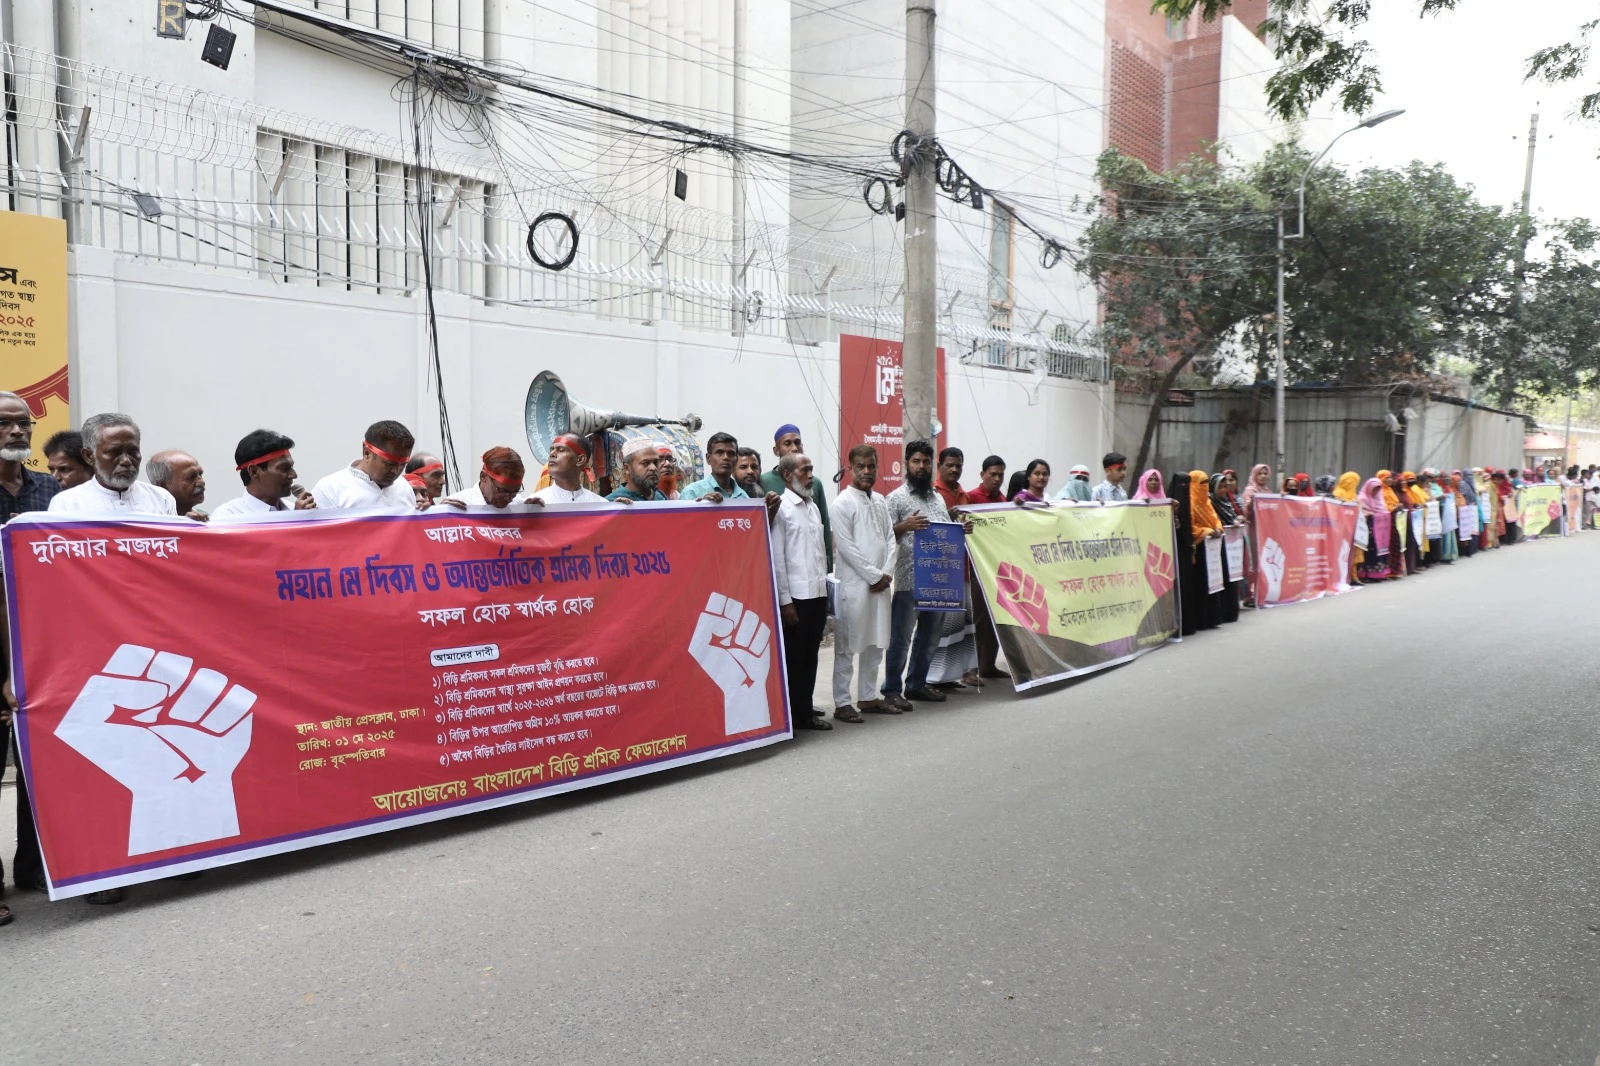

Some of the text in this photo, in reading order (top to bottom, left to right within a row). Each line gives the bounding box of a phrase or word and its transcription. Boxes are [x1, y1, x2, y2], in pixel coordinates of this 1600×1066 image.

[20, 279, 38, 289] এবং
[17, 291, 35, 303] স্বাস্থ্য
[0, 314, 35, 328] ২০২৫
[424, 525, 523, 543] আল্লাহ আকবর
[718, 518, 752, 531] এক হও
[29, 535, 181, 565] দুনিয়ার মজদুর
[276, 544, 671, 601] মহান মে দিবস ও আন্তর্জাতিক শ্রমিক দিবস ২০২৫
[1059, 577, 1086, 595] সফল
[1088, 575, 1106, 593] হোক
[418, 594, 594, 627] সফল হোক স্বার্থক হোক
[433, 646, 494, 663] আমাদের দাবী
[432, 675, 441, 689] ১)
[443, 671, 459, 686] বিড়ি
[460, 669, 489, 683] শ্রমিকসহ
[490, 668, 506, 679] সকল
[507, 663, 535, 676] শ্রমিকদের
[553, 658, 565, 674] বৃদ্ধি
[566, 658, 582, 669] করতে
[434, 693, 444, 707] ২)
[445, 689, 462, 704] বিড়ি
[464, 687, 496, 701] শ্রমিকদের
[536, 678, 553, 690] আইন
[574, 673, 592, 684] করতে
[435, 711, 446, 725] ৩)
[447, 707, 463, 722] বিড়ি
[464, 705, 495, 719] শ্রমিকদের
[605, 684, 617, 697] বিড়ি
[295, 722, 318, 736] স্থান:
[320, 716, 353, 730] জাতীয়
[355, 711, 397, 726] প্রেসক্লাব,
[437, 732, 447, 746] ৪)
[449, 728, 470, 742] বিড়ির
[472, 725, 489, 738] উপর
[491, 720, 523, 735] আরোপিত
[585, 707, 604, 719] কমাতে
[296, 729, 395, 752] তারিখ: ০১ মে ২০২৫
[439, 753, 450, 767] ৫)
[451, 749, 472, 762] অবৈধ
[474, 744, 495, 759] বিড়ির
[496, 740, 517, 755] তৈরির
[557, 731, 575, 743] করতে
[330, 747, 386, 769] বৃহস্পতিবার
[372, 733, 687, 812] আয়োজনেঃ বাংলাদেশ বিড়ি শ্রমিক ফেডারেশন
